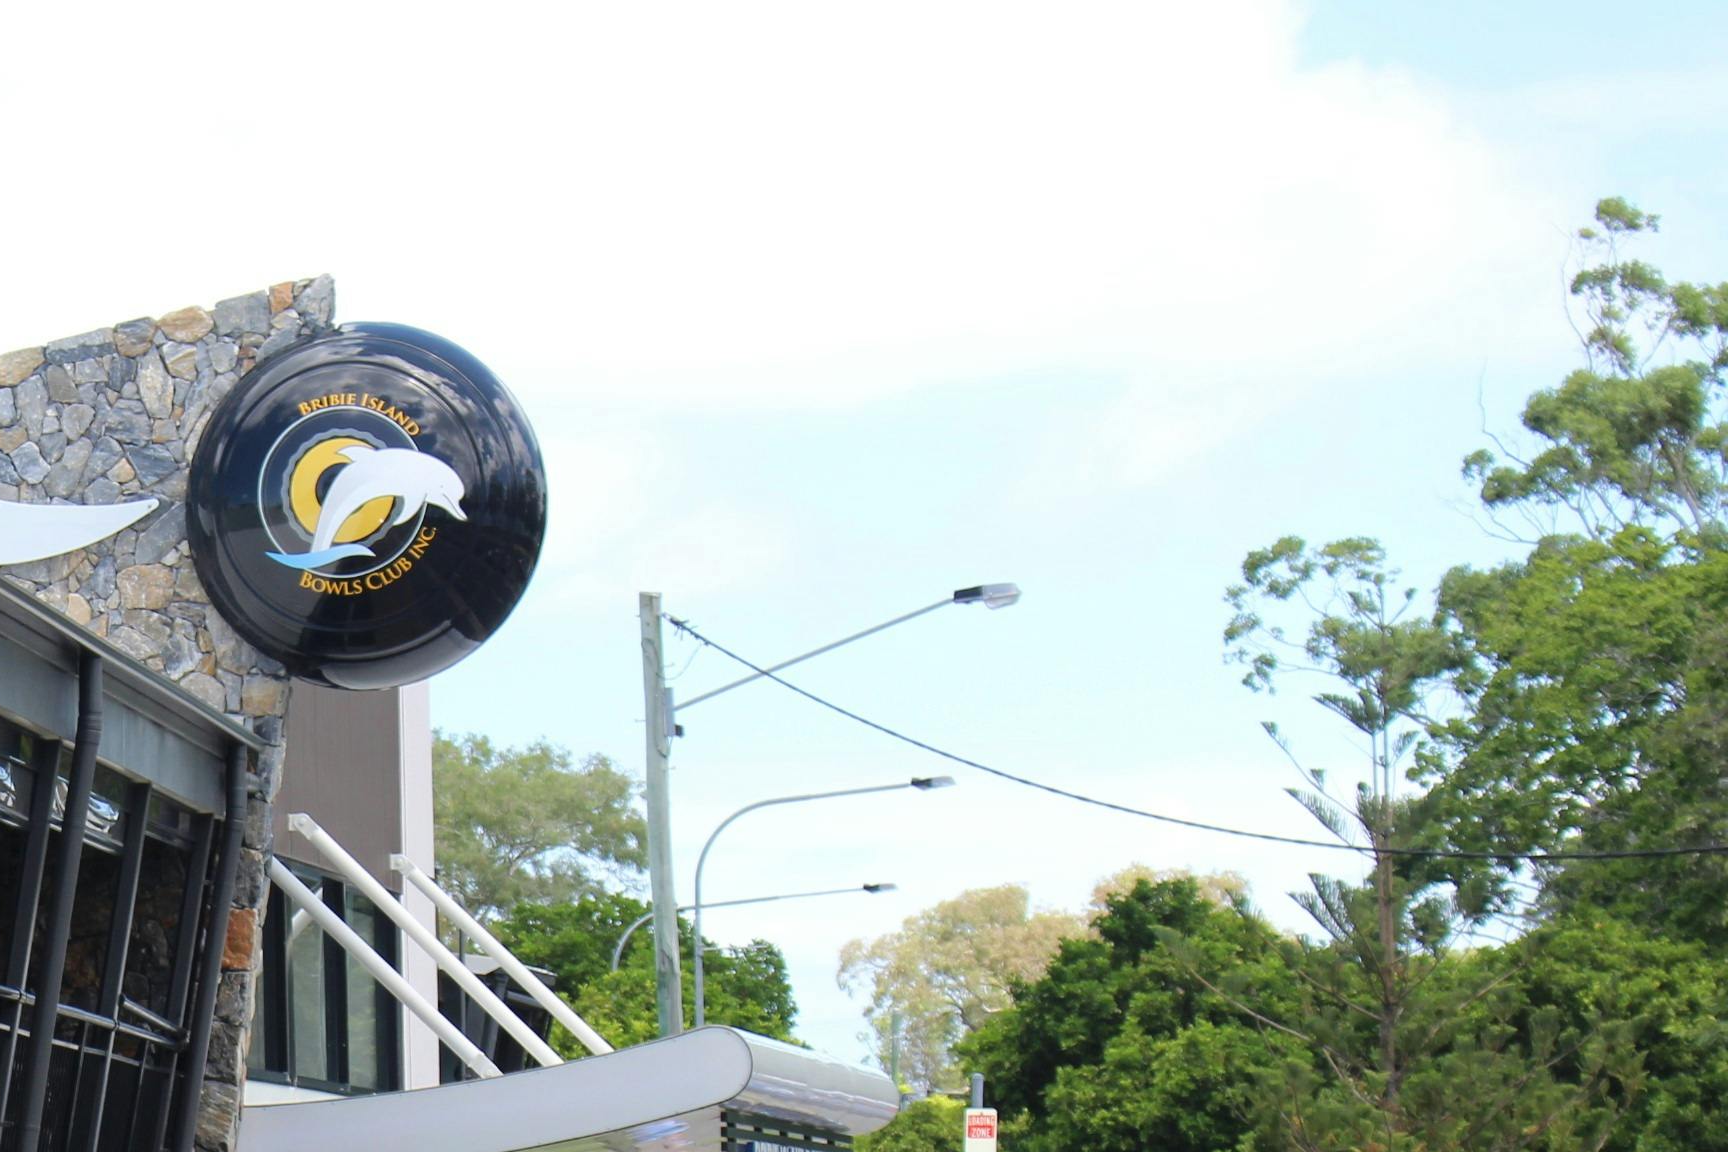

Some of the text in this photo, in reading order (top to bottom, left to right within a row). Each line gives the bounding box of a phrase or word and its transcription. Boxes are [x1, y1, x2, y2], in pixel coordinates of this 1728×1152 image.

[298, 393, 421, 437] BRIBIE ISLAND
[299, 571, 363, 595] BOWLS
[365, 557, 413, 590] CLUB
[969, 1115, 994, 1126] LOADING
[972, 1128, 992, 1138] ZONE
